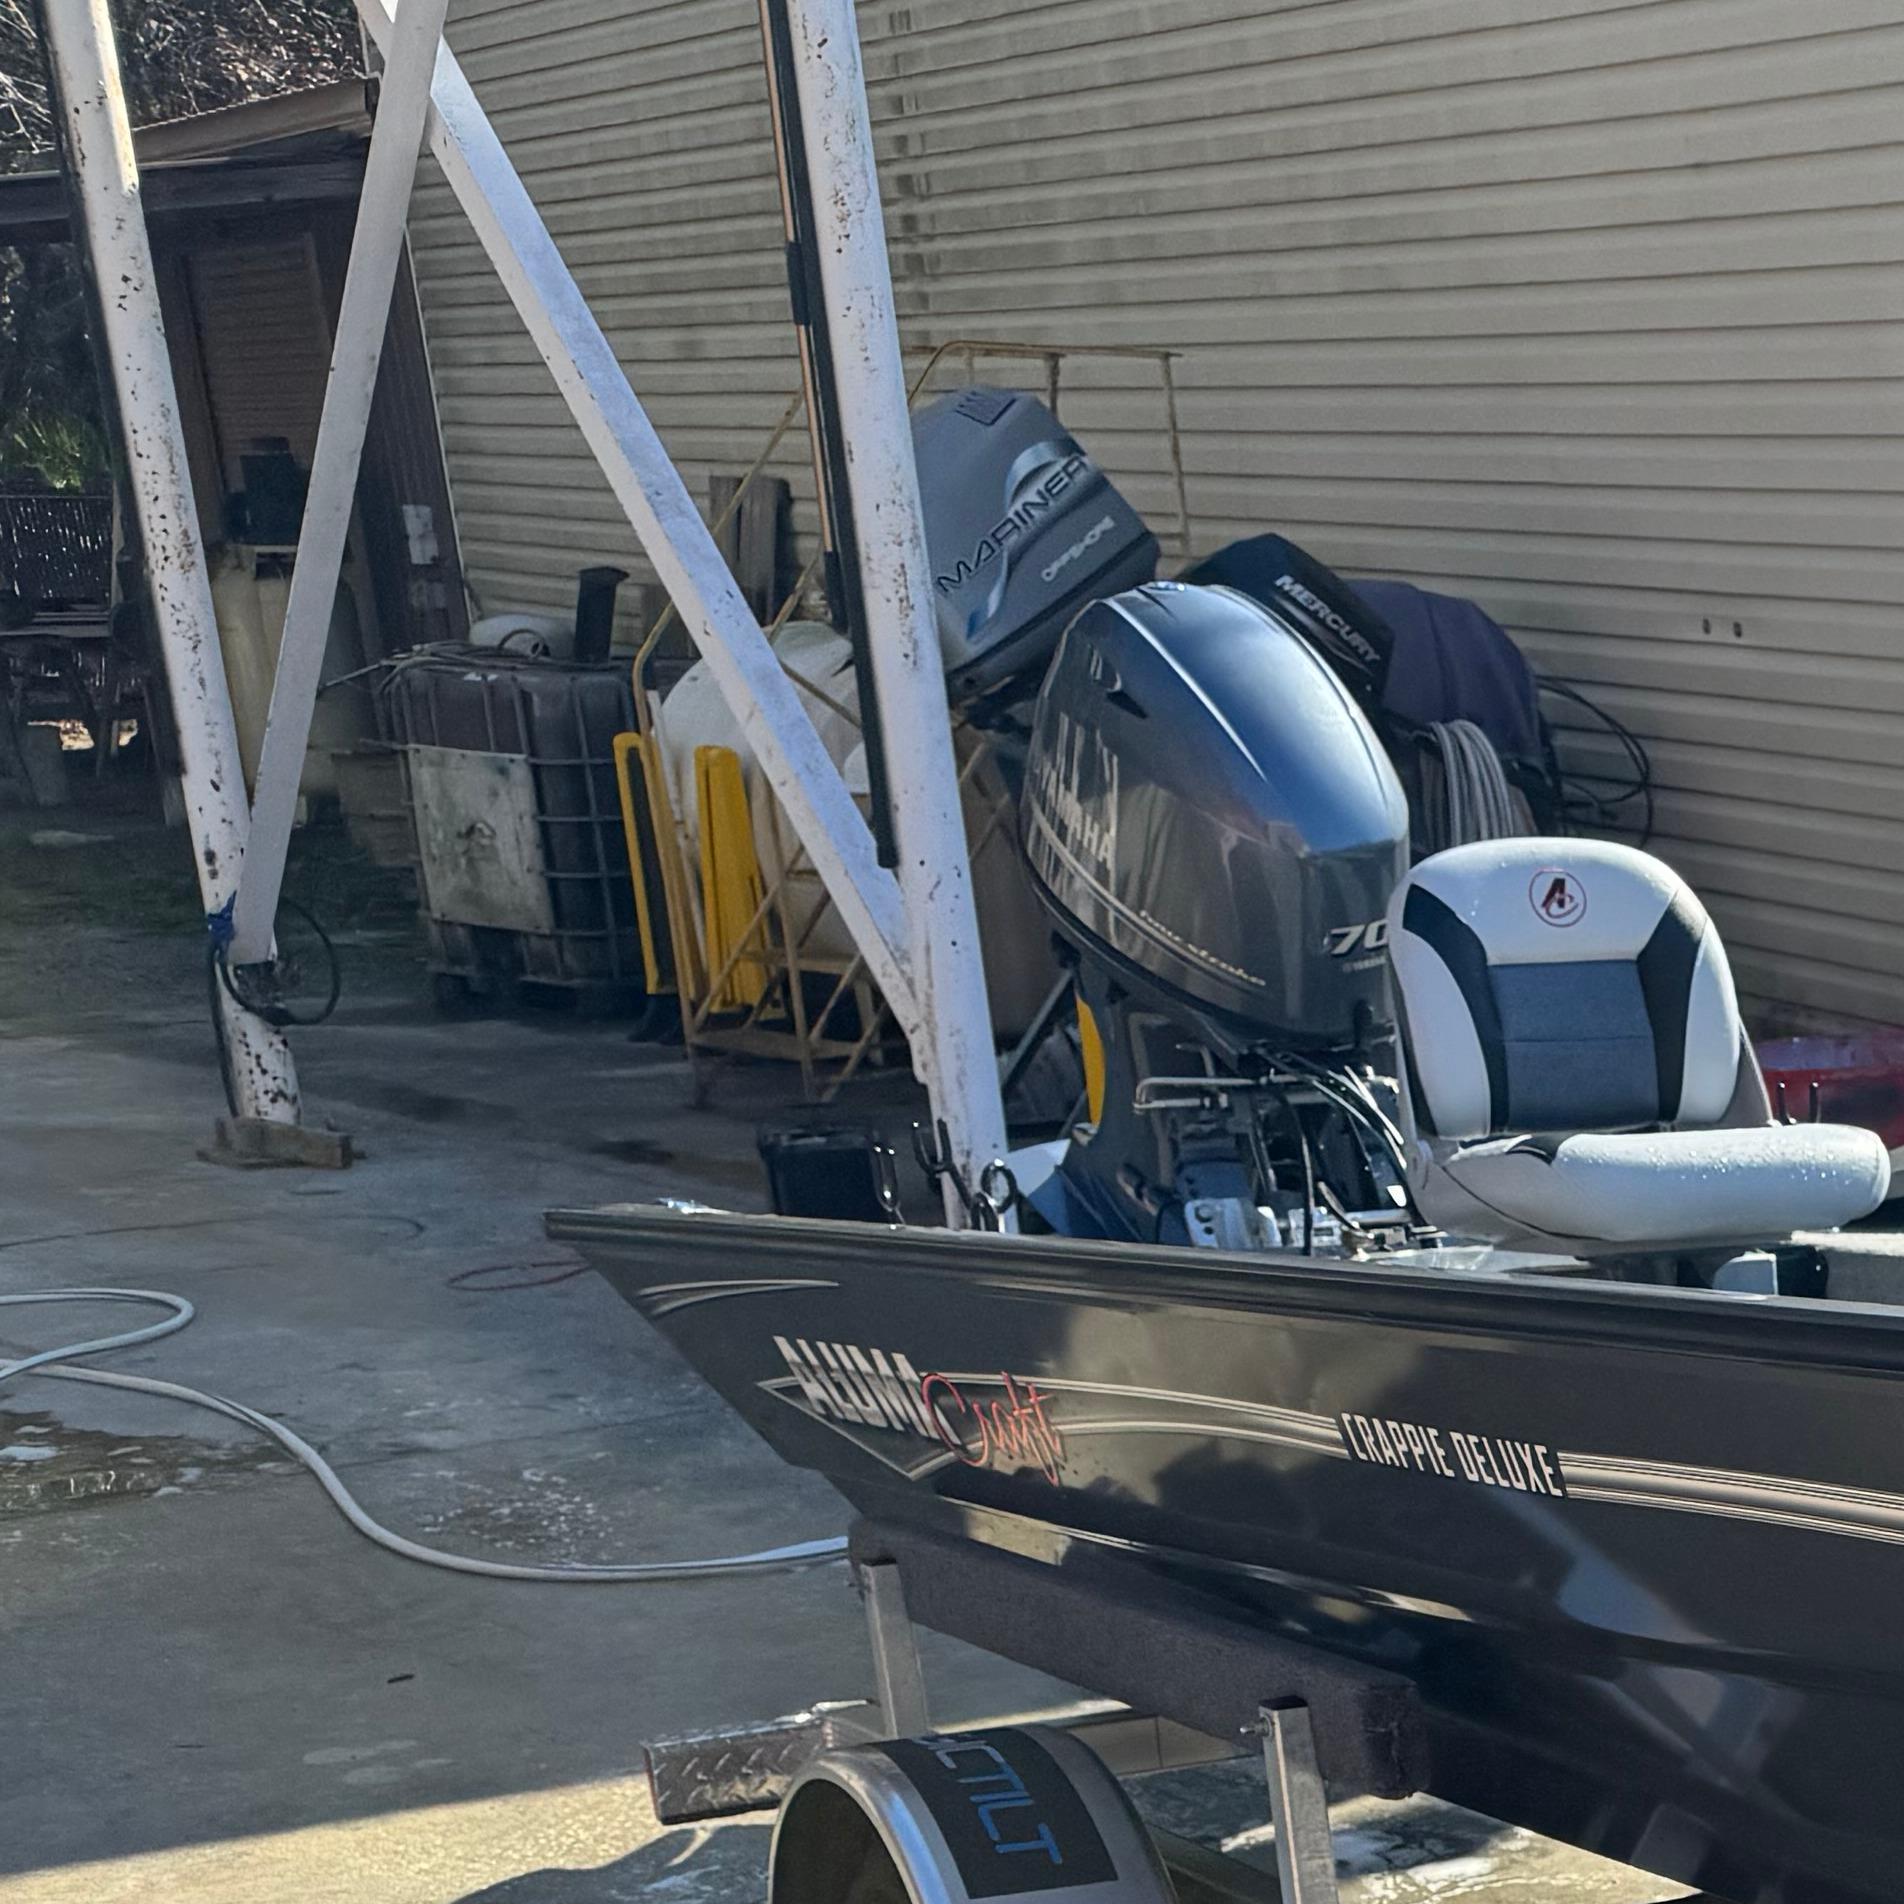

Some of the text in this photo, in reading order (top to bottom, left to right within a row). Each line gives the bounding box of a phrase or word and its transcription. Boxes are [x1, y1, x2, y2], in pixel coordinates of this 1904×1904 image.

[936, 453, 1088, 592] MARINER
[1274, 575, 1381, 661] MERCURY
[1331, 918, 1389, 956] 70
[1341, 1413, 1563, 1498] CRAPPIE DELUXE
